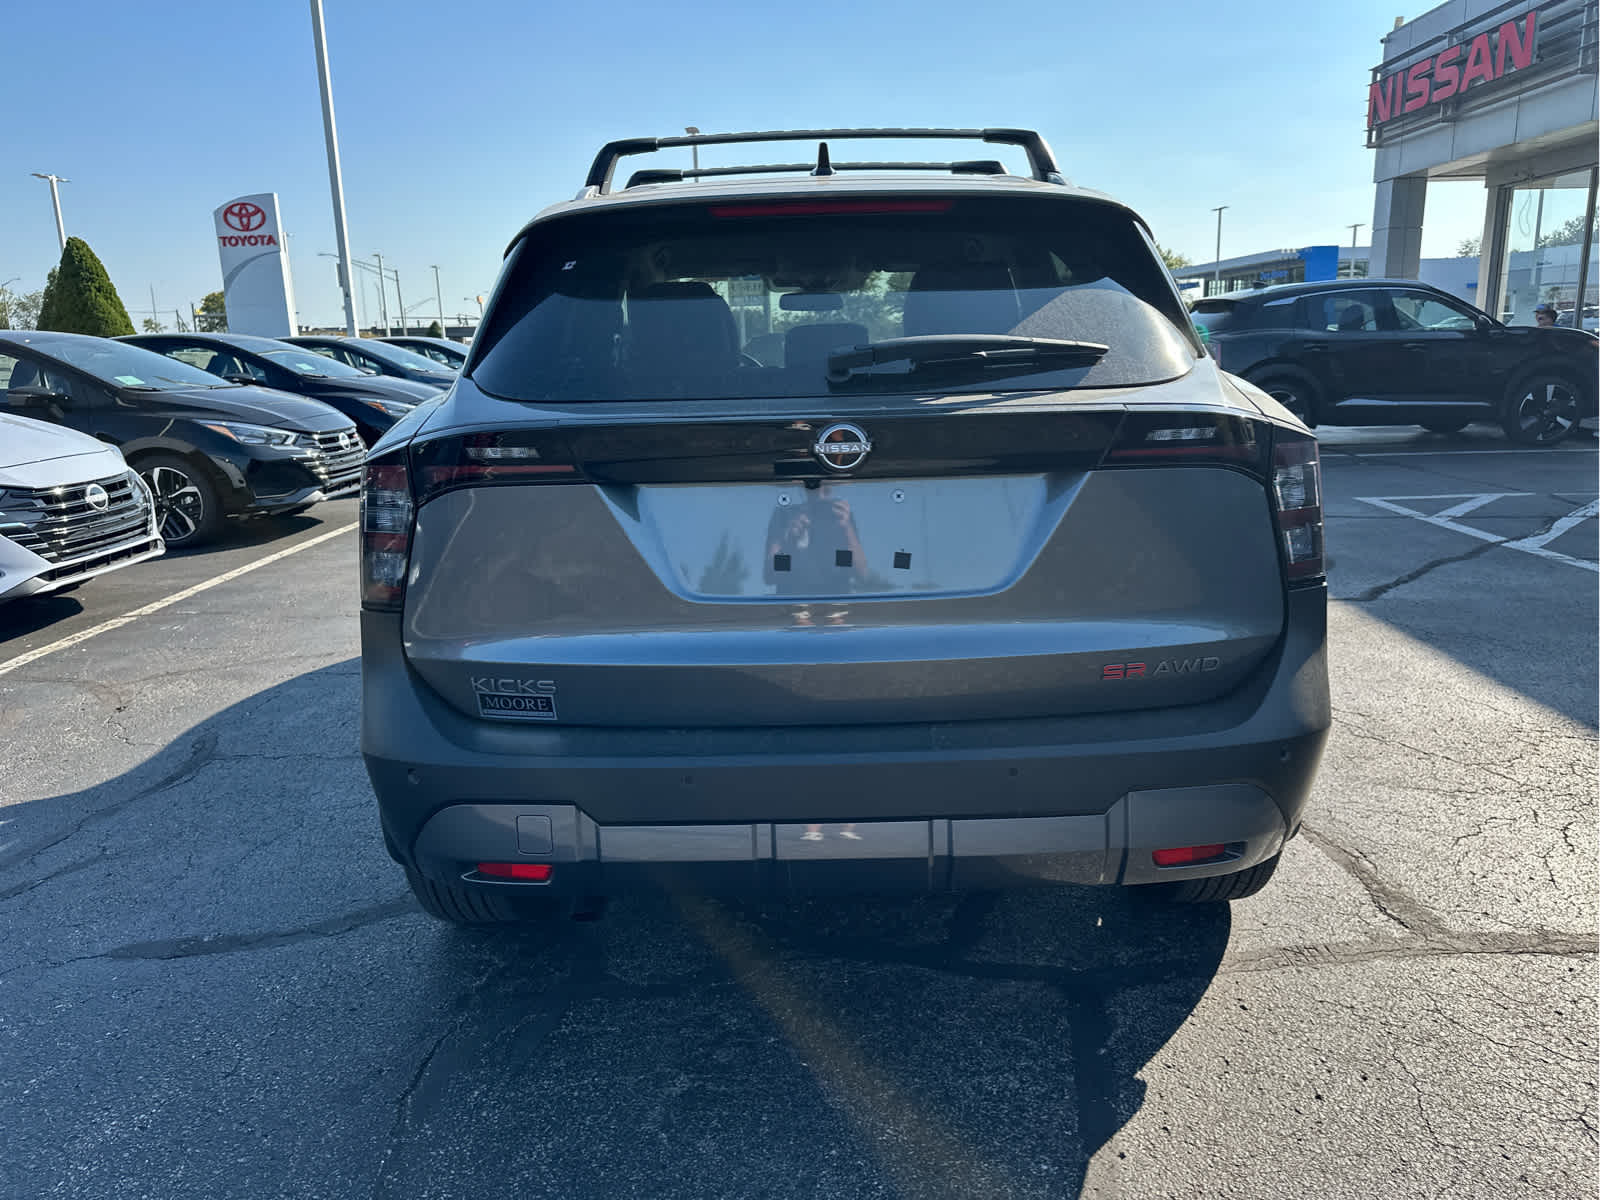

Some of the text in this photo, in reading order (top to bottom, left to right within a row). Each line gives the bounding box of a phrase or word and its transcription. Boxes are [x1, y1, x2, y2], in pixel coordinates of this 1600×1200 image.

[1367, 12, 1537, 128] NISSAN
[218, 234, 278, 248] TOYOTA
[815, 443, 872, 453] NISSAN
[1103, 656, 1221, 680] SR AWD
[471, 676, 556, 694] KICKS
[485, 697, 549, 711] MOORE
